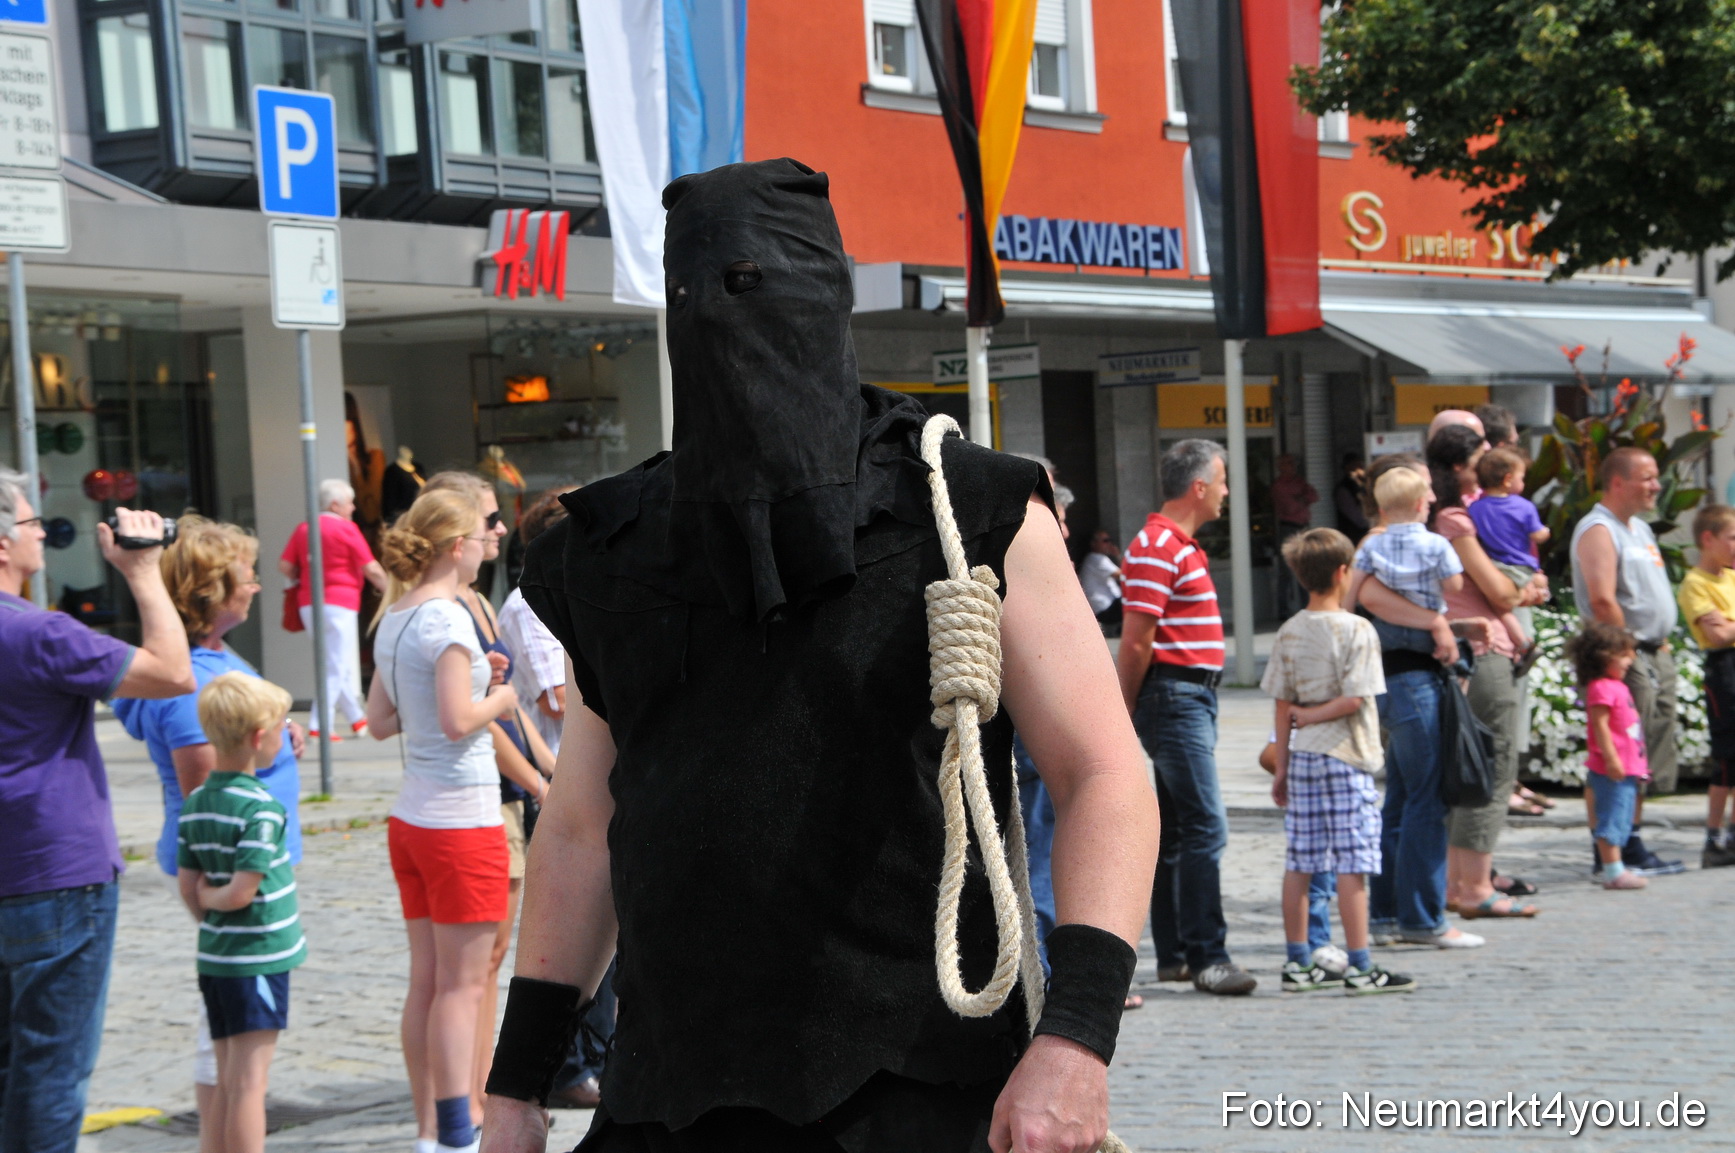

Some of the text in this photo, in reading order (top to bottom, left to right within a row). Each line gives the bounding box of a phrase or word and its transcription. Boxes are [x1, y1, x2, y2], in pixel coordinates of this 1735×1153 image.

[274, 105, 318, 199] P
[490, 208, 570, 302] H&M
[993, 213, 1184, 270] ABAKWAREN
